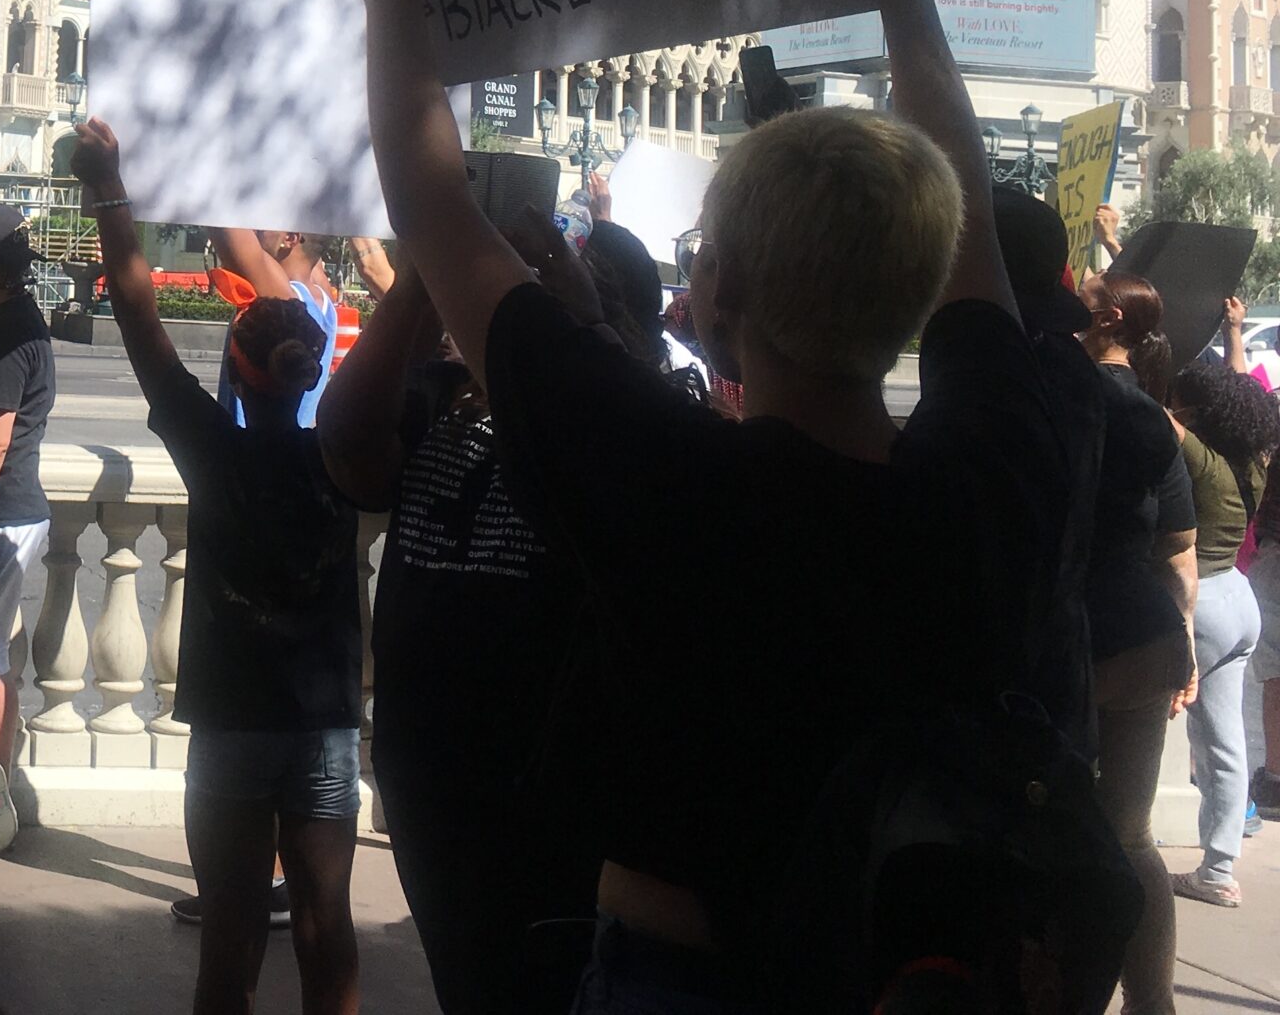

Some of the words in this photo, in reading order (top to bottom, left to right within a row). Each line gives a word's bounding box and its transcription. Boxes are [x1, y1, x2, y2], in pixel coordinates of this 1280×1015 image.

[969, 0, 984, 8] still
[987, 0, 1022, 12] burning
[961, 31, 1007, 47] Venetian
[1010, 35, 1044, 50] Resort
[484, 81, 517, 94] GRAND
[485, 93, 516, 107] CANAL
[484, 105, 517, 118] SHOPPES
[1059, 123, 1116, 172] ENOUGH
[1064, 174, 1085, 221] IS
